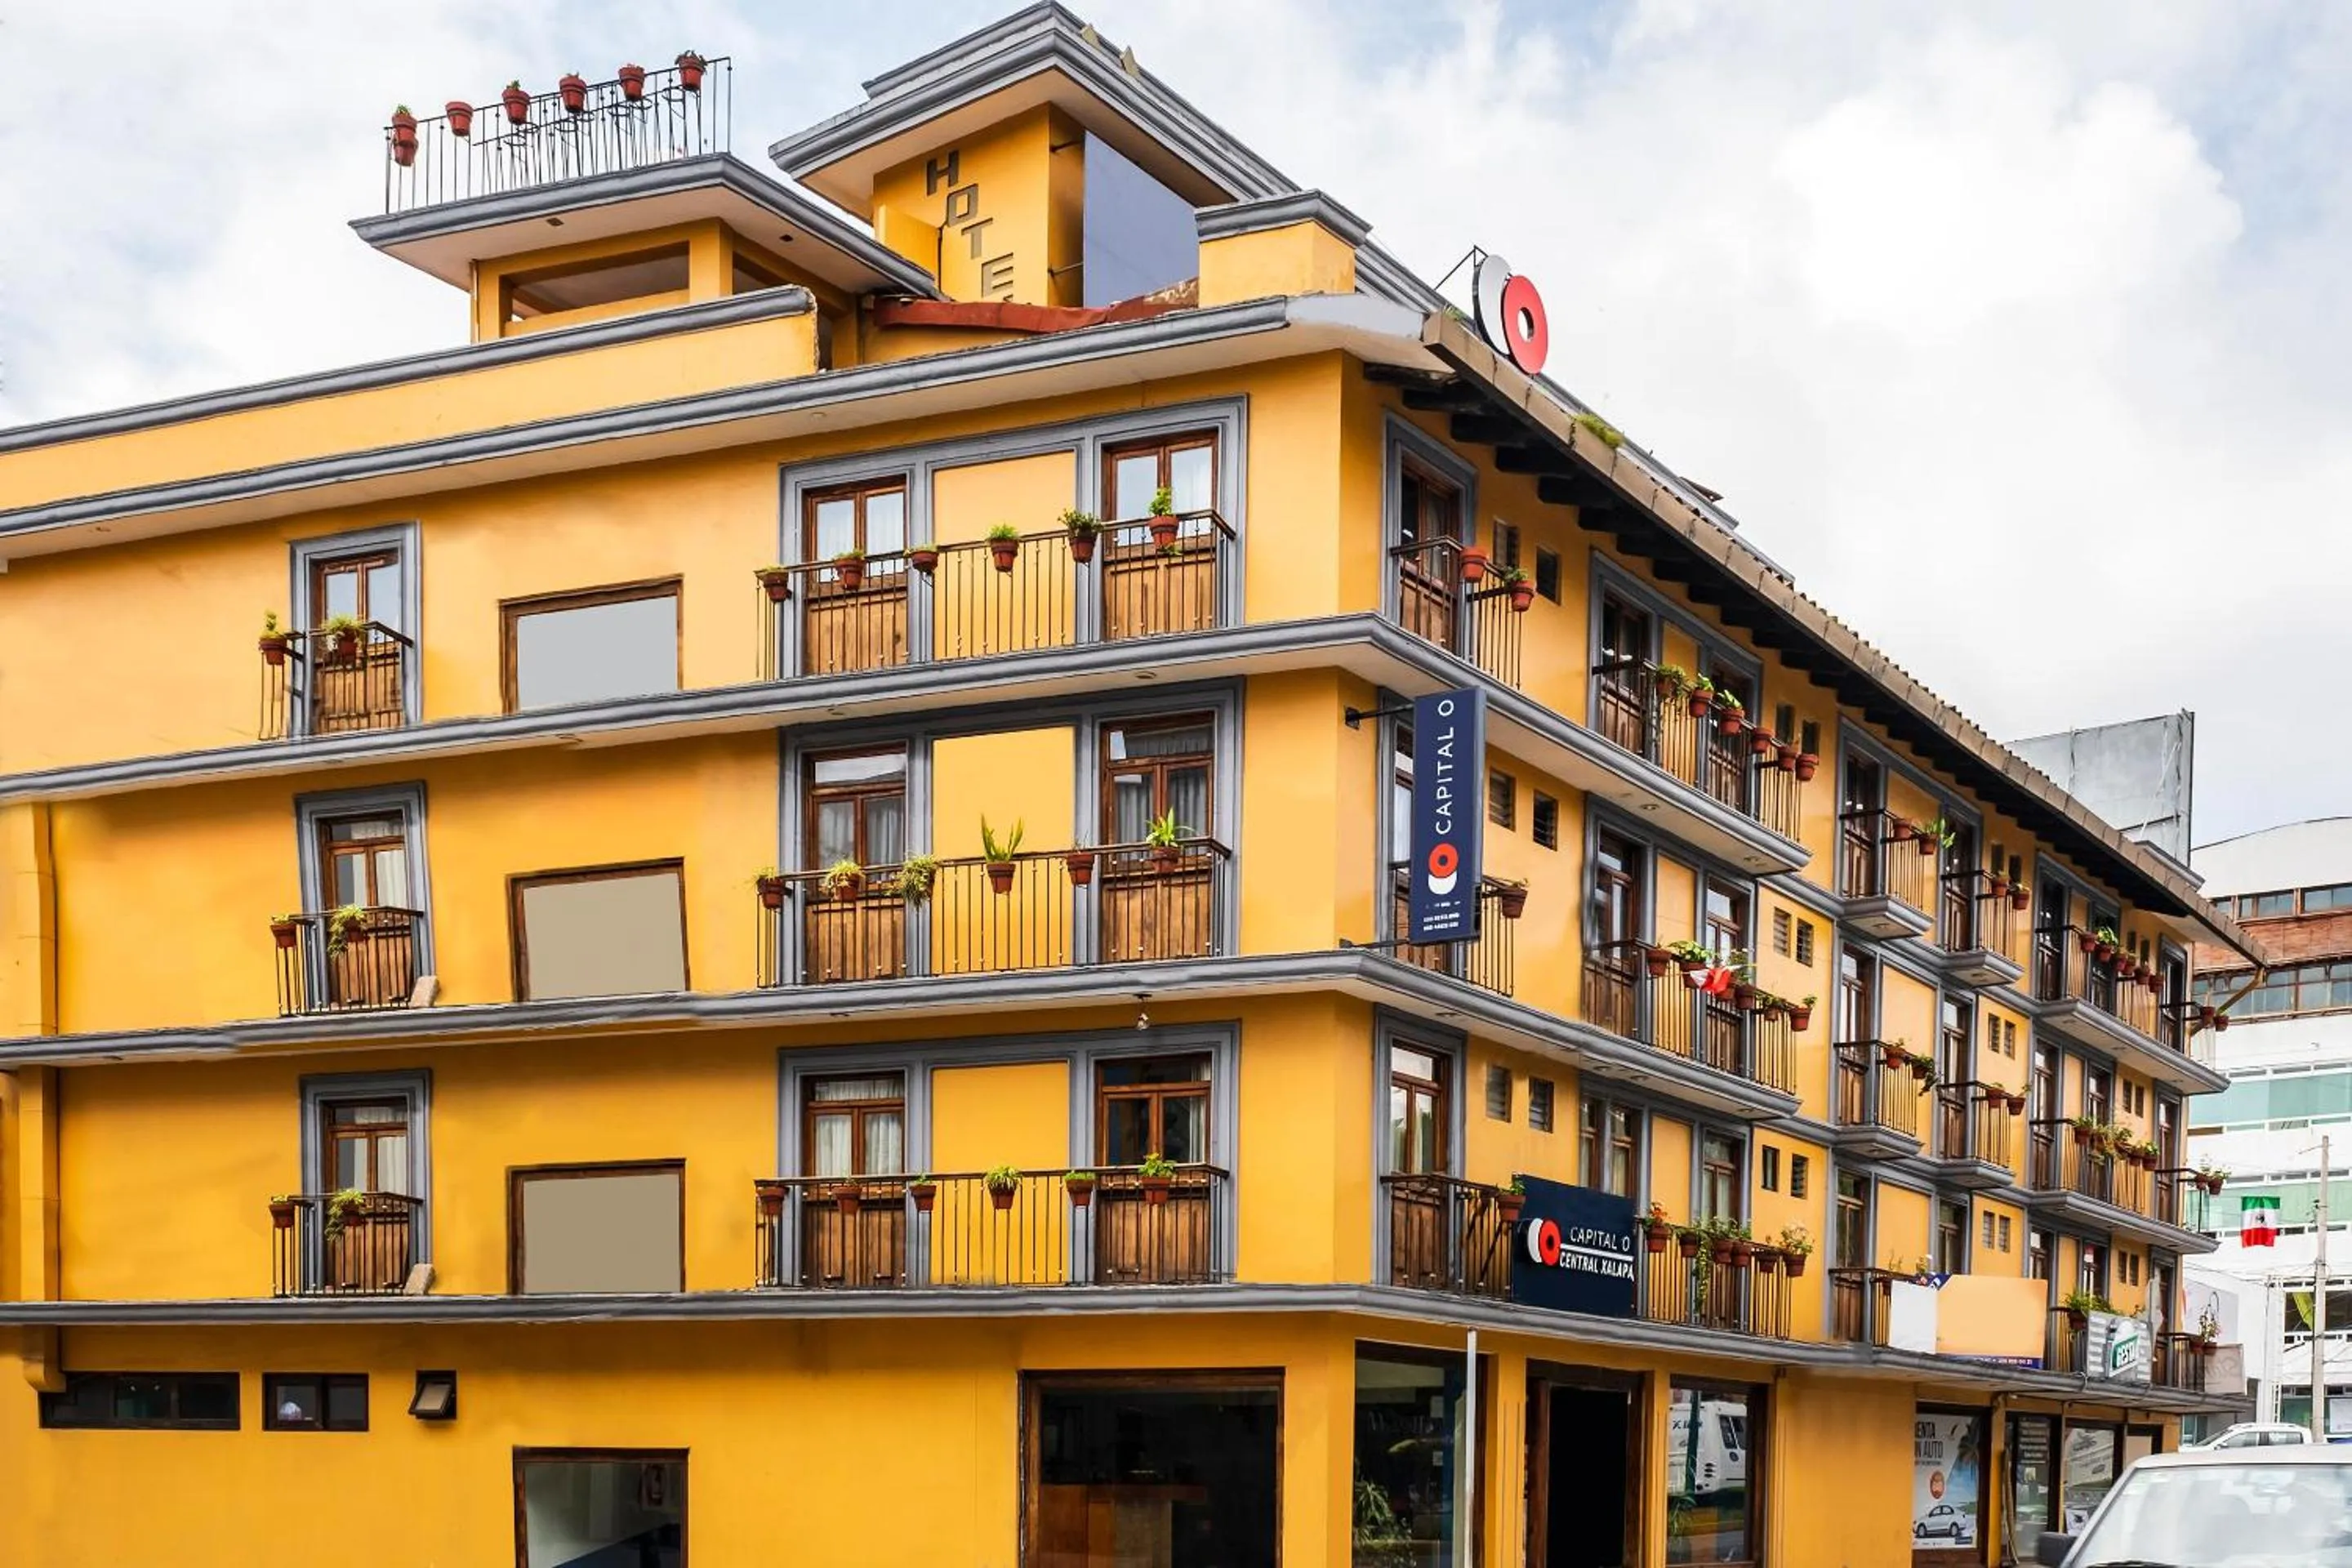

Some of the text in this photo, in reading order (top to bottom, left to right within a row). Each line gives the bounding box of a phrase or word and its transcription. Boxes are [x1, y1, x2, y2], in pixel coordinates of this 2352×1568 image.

[926, 149, 1014, 301] HOTE
[1436, 699, 1454, 835] CAPITAL O
[1570, 1227, 1630, 1252] CAPITAL O
[1559, 1251, 1634, 1282] CENTRAL XALAPA
[1922, 1441, 1944, 1459] AUTO
